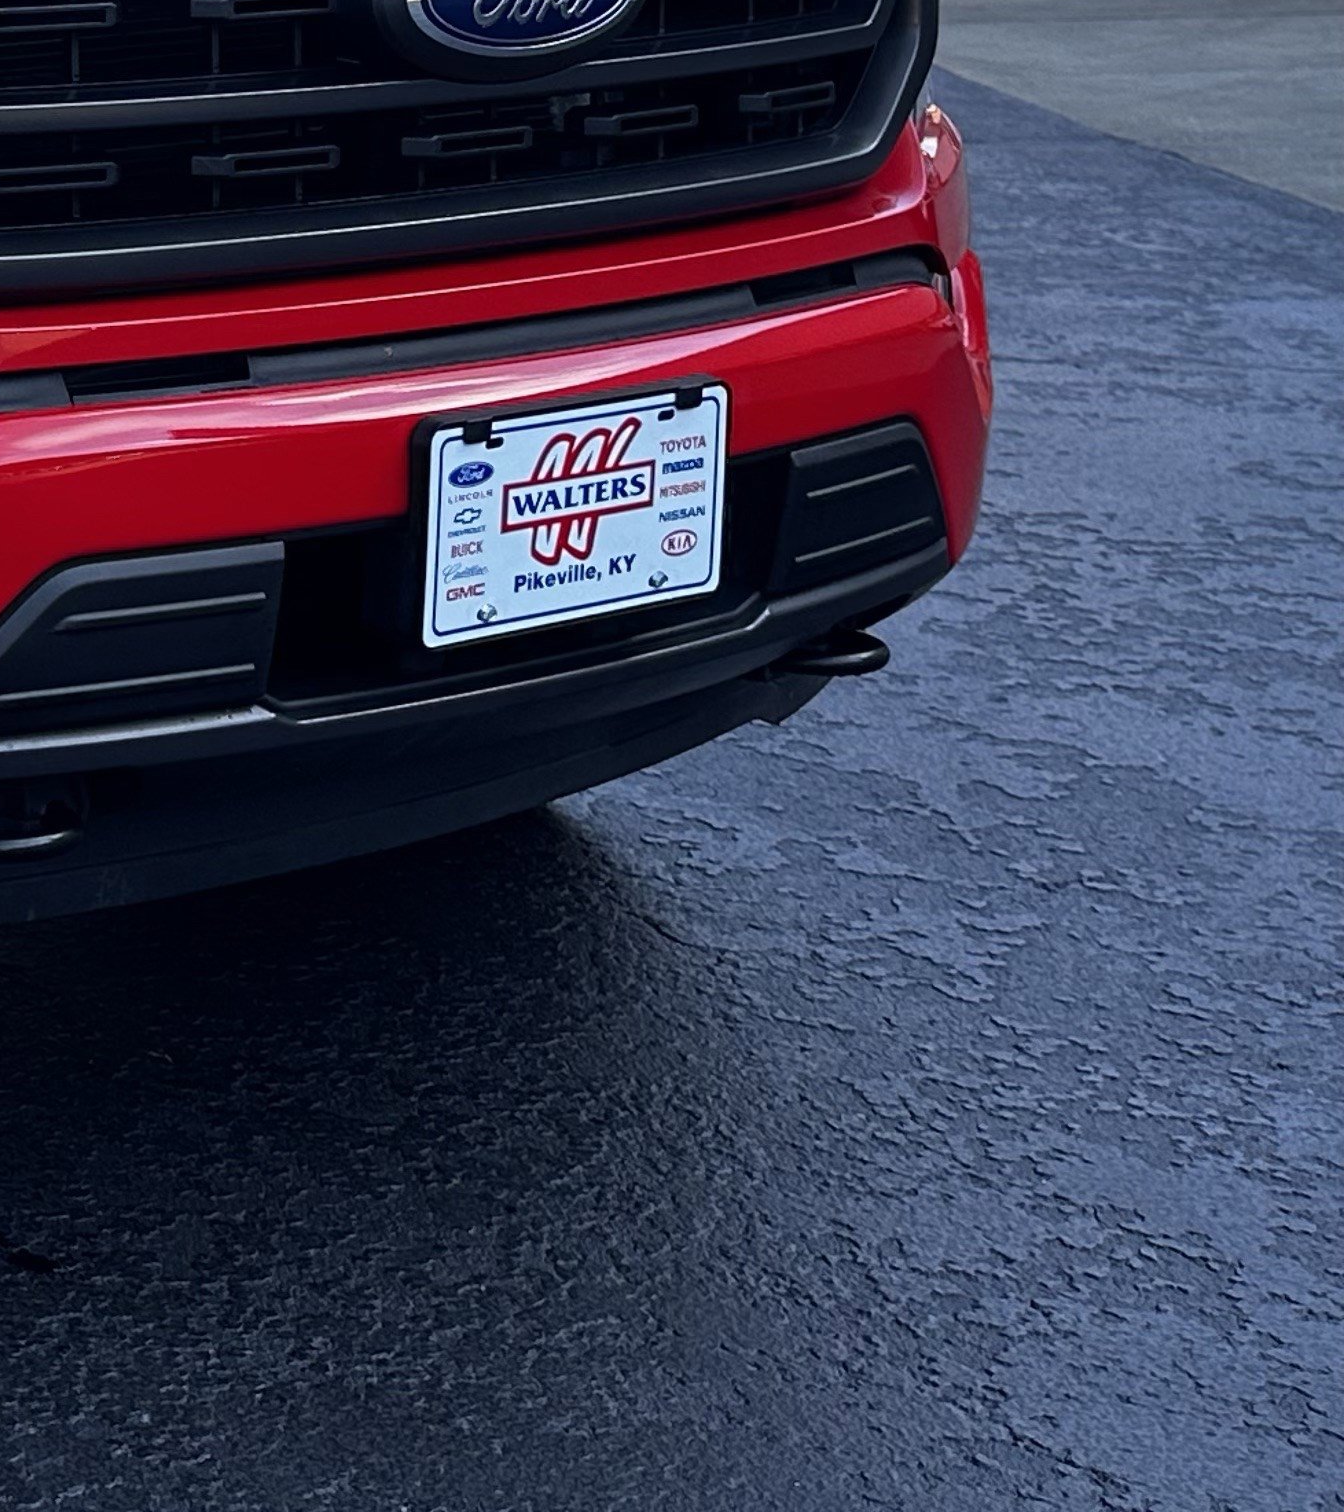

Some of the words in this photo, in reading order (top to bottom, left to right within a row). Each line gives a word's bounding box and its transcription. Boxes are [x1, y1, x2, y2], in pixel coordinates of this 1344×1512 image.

[659, 435, 707, 455] TOYOTA
[457, 463, 486, 483] Ford
[512, 473, 647, 517] WALTERS
[659, 505, 706, 522] NISSAN
[451, 540, 484, 559] BUICK
[667, 534, 692, 551] KIA
[514, 565, 602, 593] Pikeville,
[608, 553, 637, 576] KY
[446, 583, 485, 602] GMC
